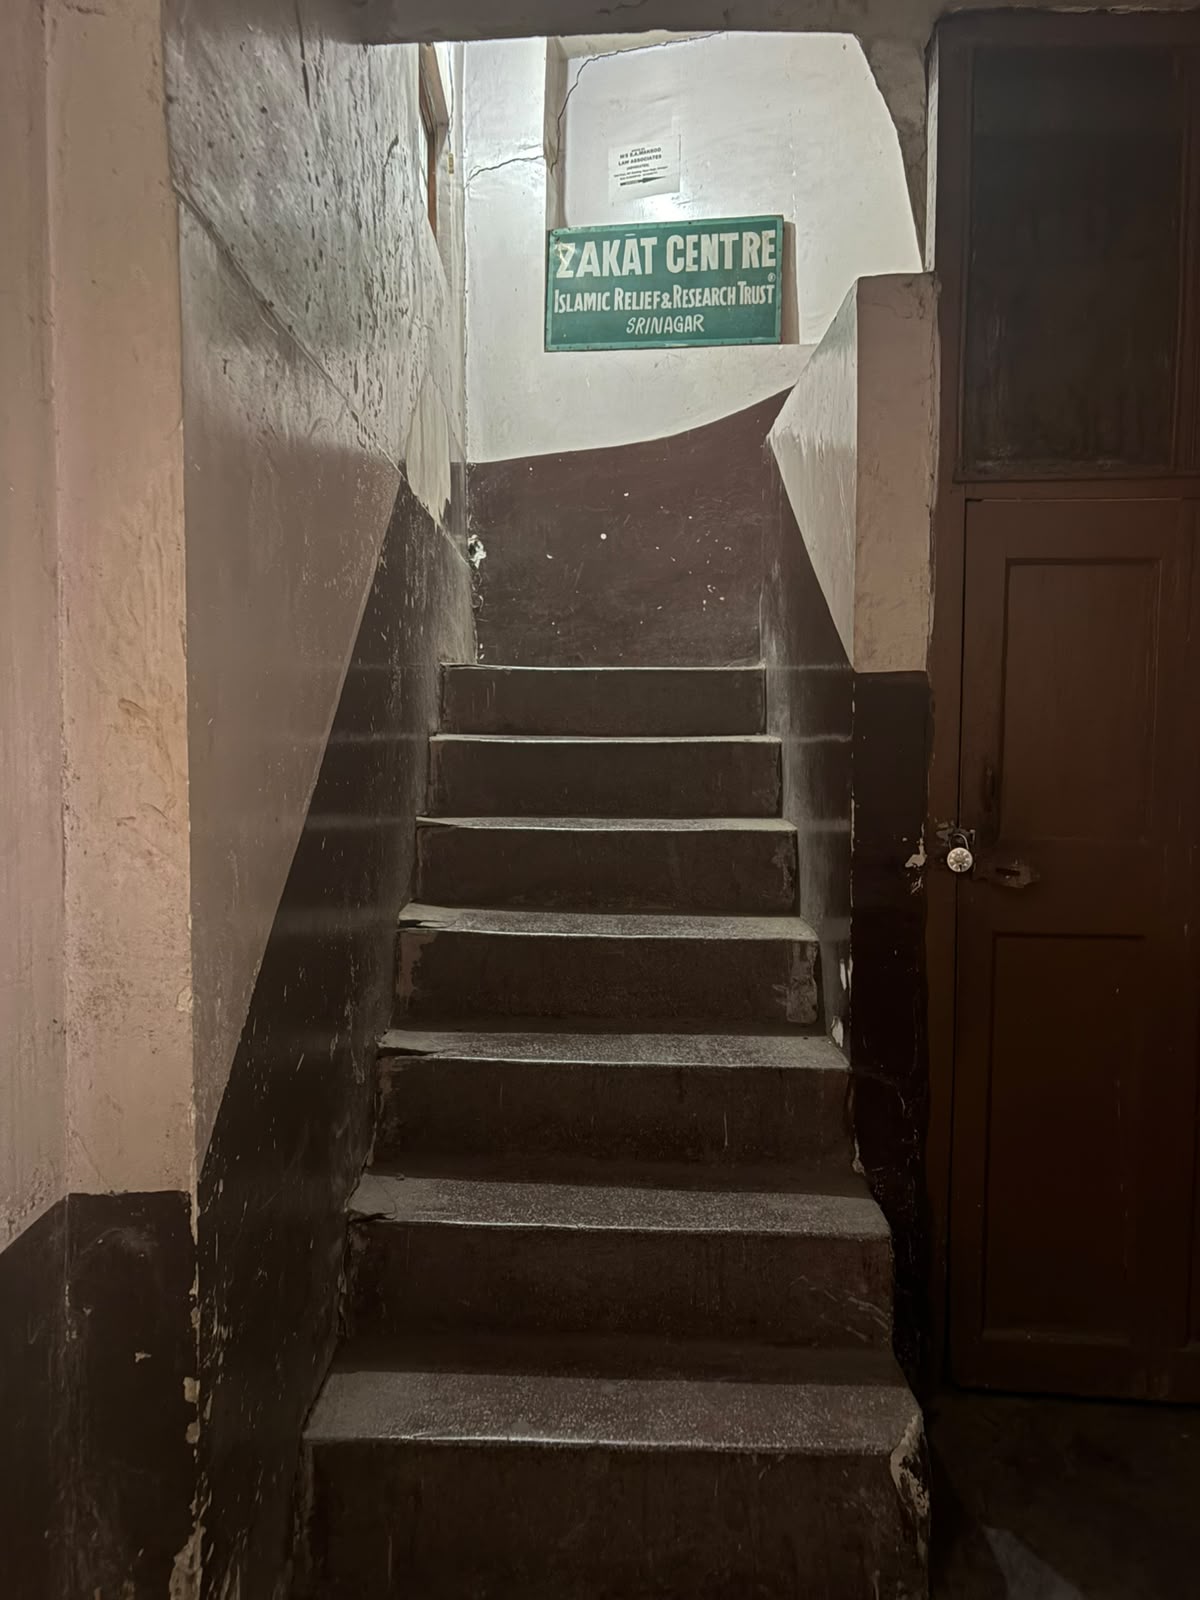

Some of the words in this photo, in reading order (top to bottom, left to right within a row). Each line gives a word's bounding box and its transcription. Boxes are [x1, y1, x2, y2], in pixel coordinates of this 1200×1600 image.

[666, 229, 777, 273] CENTRE
[554, 289, 611, 314] ISLAMIC
[737, 280, 775, 305] TRUST
[626, 313, 705, 335] SRINAGAR
